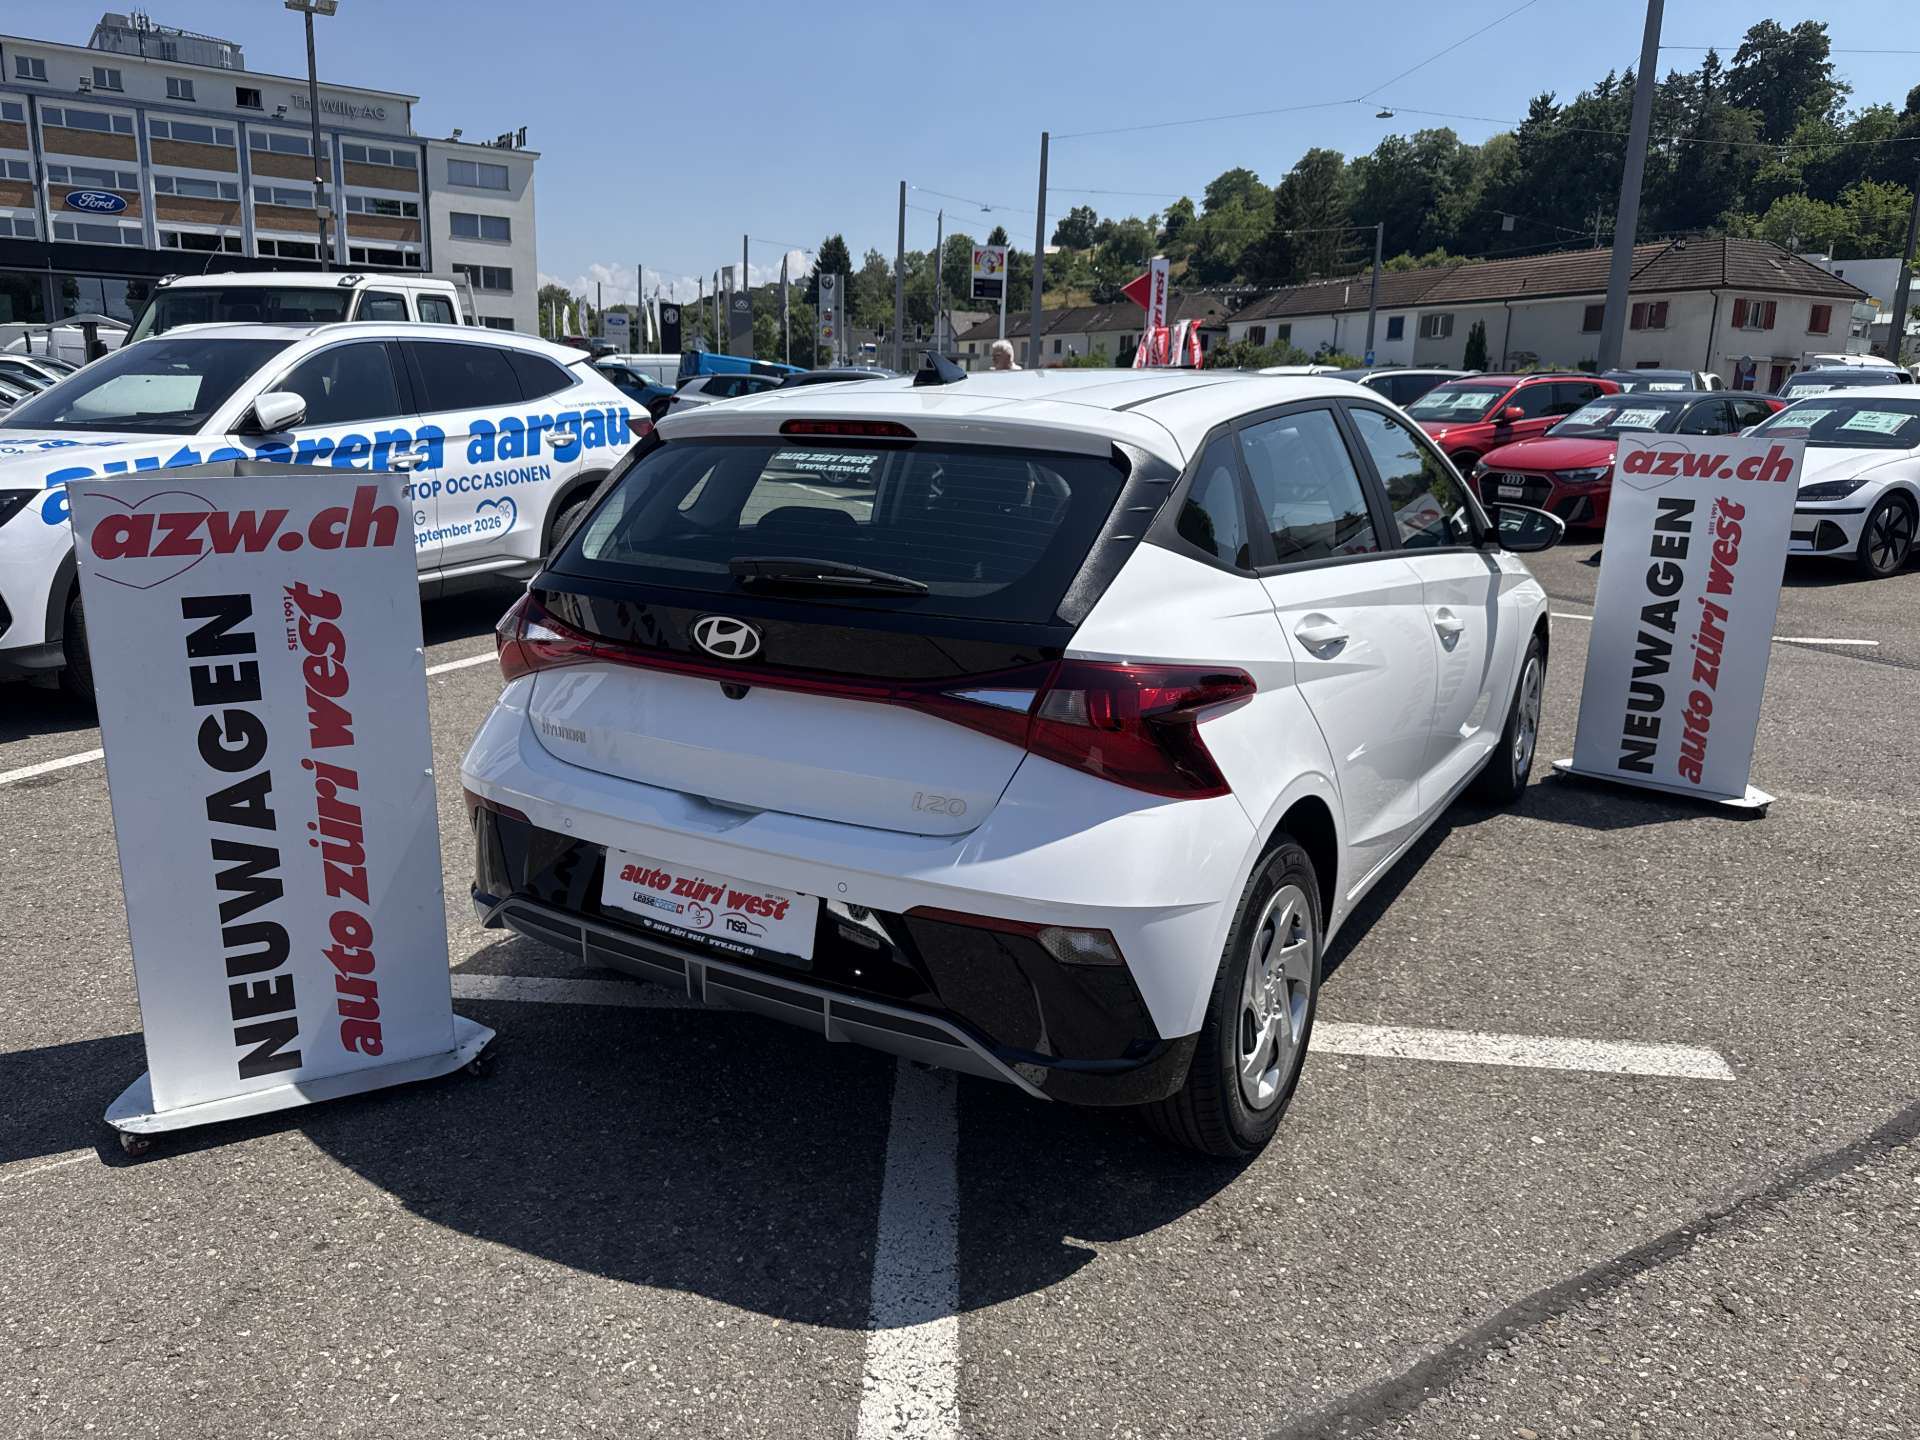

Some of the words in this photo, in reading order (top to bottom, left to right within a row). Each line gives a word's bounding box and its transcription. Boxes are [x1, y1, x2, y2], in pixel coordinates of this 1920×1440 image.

[361, 104, 387, 121] AG
[78, 192, 115, 209] Ford
[467, 406, 630, 464] aargau
[1623, 445, 1794, 482] azw.ch
[410, 481, 441, 500] TOP
[446, 465, 551, 497] OCCASIONEN
[91, 485, 399, 560] azw.ch
[414, 522, 471, 548] eptember
[474, 515, 501, 534] 2026
[1706, 495, 1746, 596] west
[283, 596, 295, 622] 1991
[1617, 497, 1696, 774] NEUWAGEN
[283, 580, 355, 749] west
[286, 628, 298, 652] SEIT
[1690, 596, 1729, 692] züri
[542, 720, 587, 744] HYUNDAI
[1678, 690, 1713, 784] auto
[181, 593, 303, 1080] NEUWAGEN
[300, 757, 370, 905] züri
[619, 863, 672, 891] auto
[671, 876, 727, 905] züri
[727, 889, 791, 921] west
[726, 918, 748, 934] nsa
[321, 910, 384, 1057] auto
